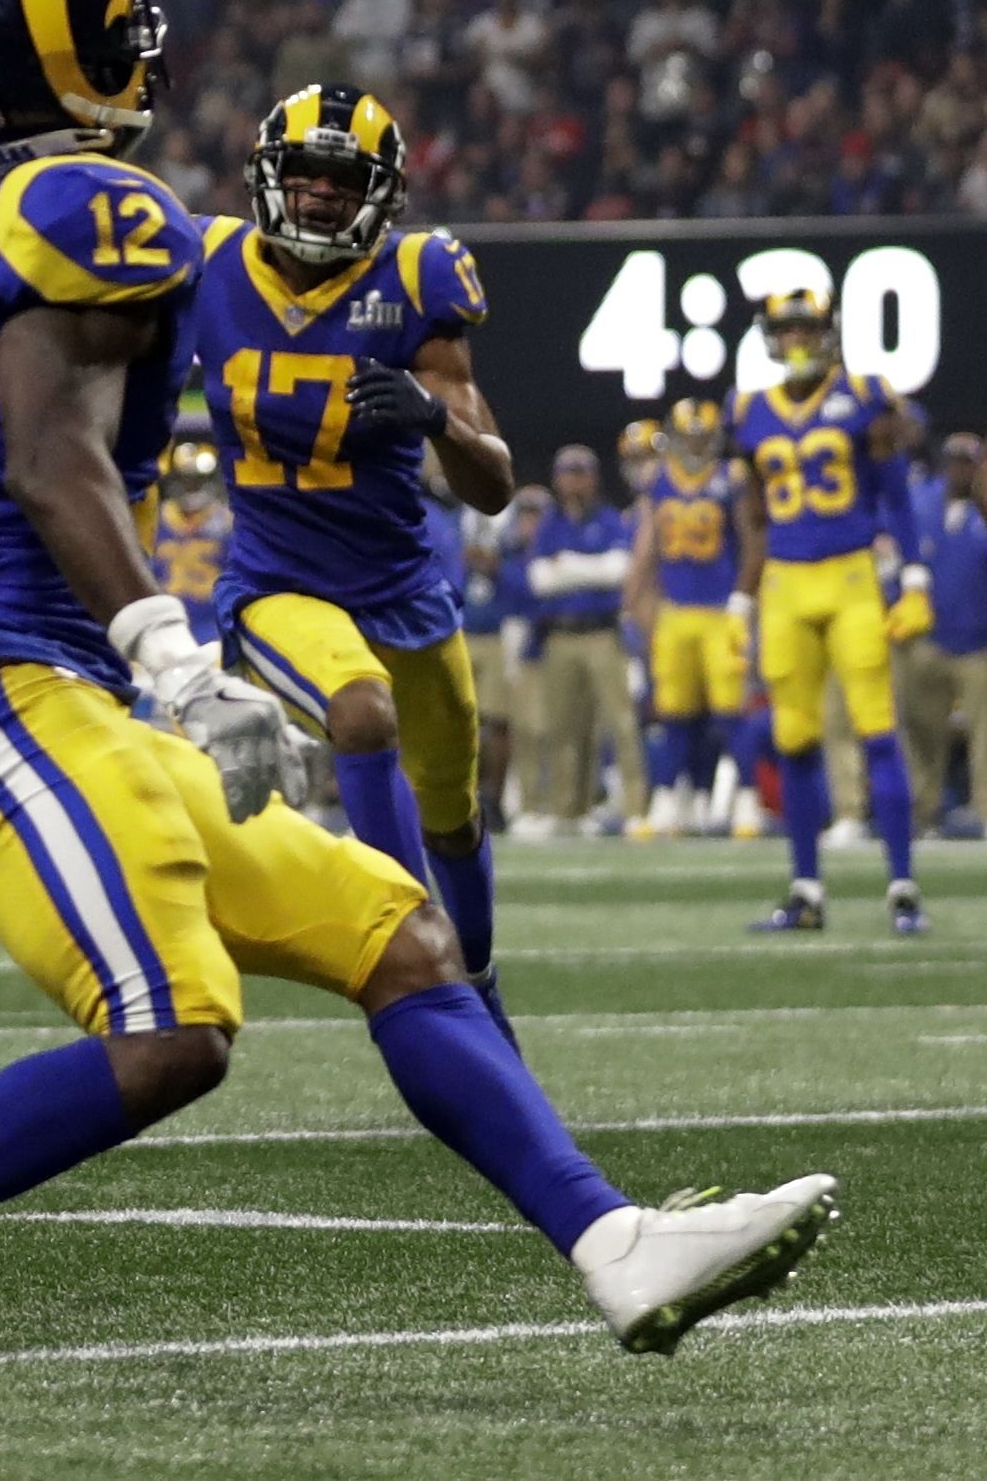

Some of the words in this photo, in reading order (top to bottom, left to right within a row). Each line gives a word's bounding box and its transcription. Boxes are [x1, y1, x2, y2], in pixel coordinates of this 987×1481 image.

[88, 192, 171, 268] 12
[579, 246, 942, 400] 4:20
[222, 346, 356, 492] 17
[755, 426, 857, 524] 83
